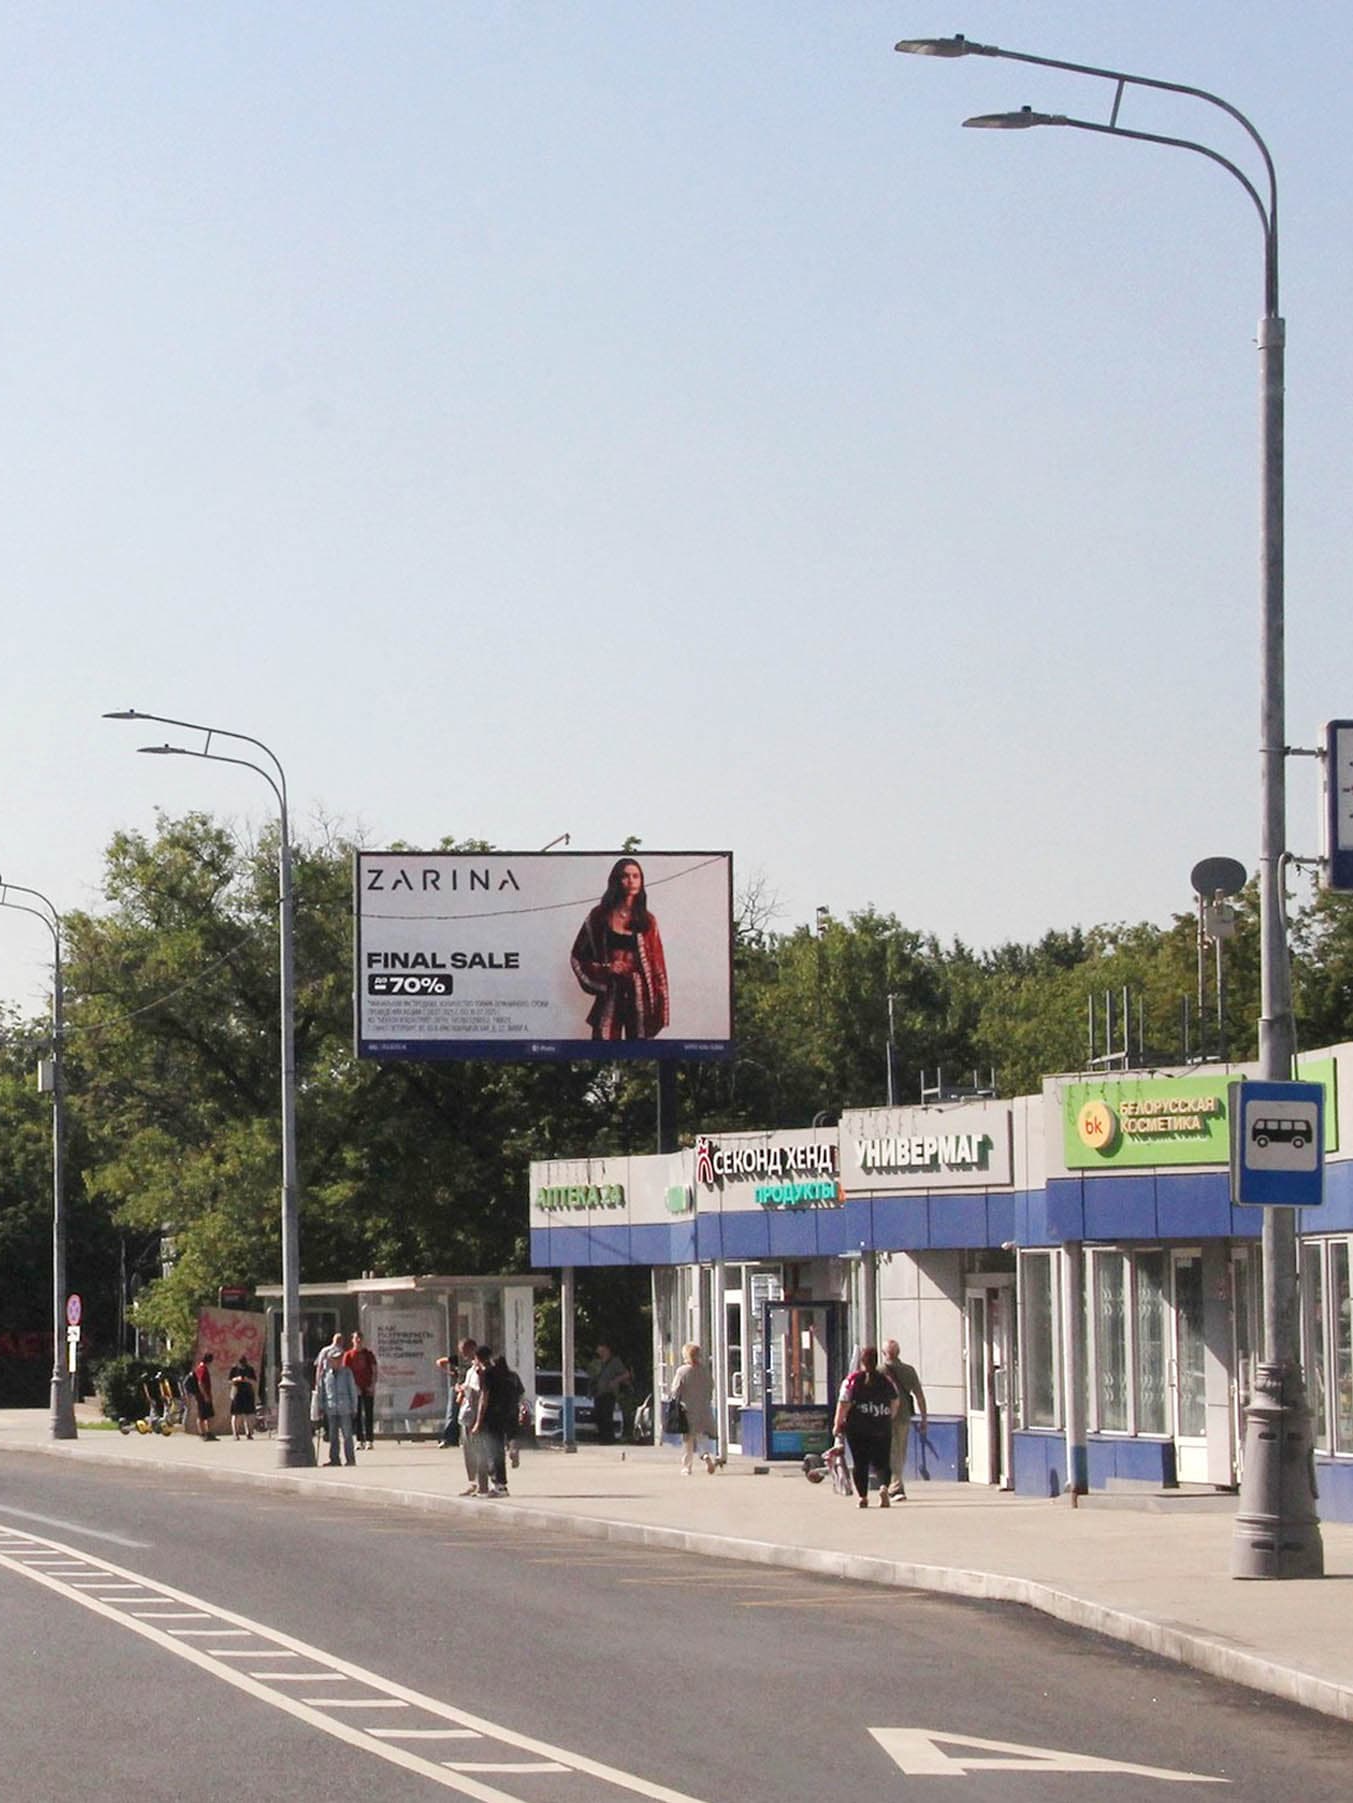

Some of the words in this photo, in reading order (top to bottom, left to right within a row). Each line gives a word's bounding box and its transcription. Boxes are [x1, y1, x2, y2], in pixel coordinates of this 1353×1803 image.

[367, 869, 520, 891] ZARINA
[367, 952, 446, 969] FINAL
[450, 952, 520, 969] SALE
[1120, 1097, 1216, 1116] БЕЛОРУССКАЯ
[1120, 1115, 1202, 1133] КОСМЕТИКА
[713, 1148, 782, 1176] СЕКОНД
[787, 1143, 833, 1173] ХЕНД
[854, 1134, 983, 1168] УНИВЕРМАГ
[535, 1184, 599, 1208] АПТЕКА
[754, 1180, 835, 1204] ПРОДУКТЫ
